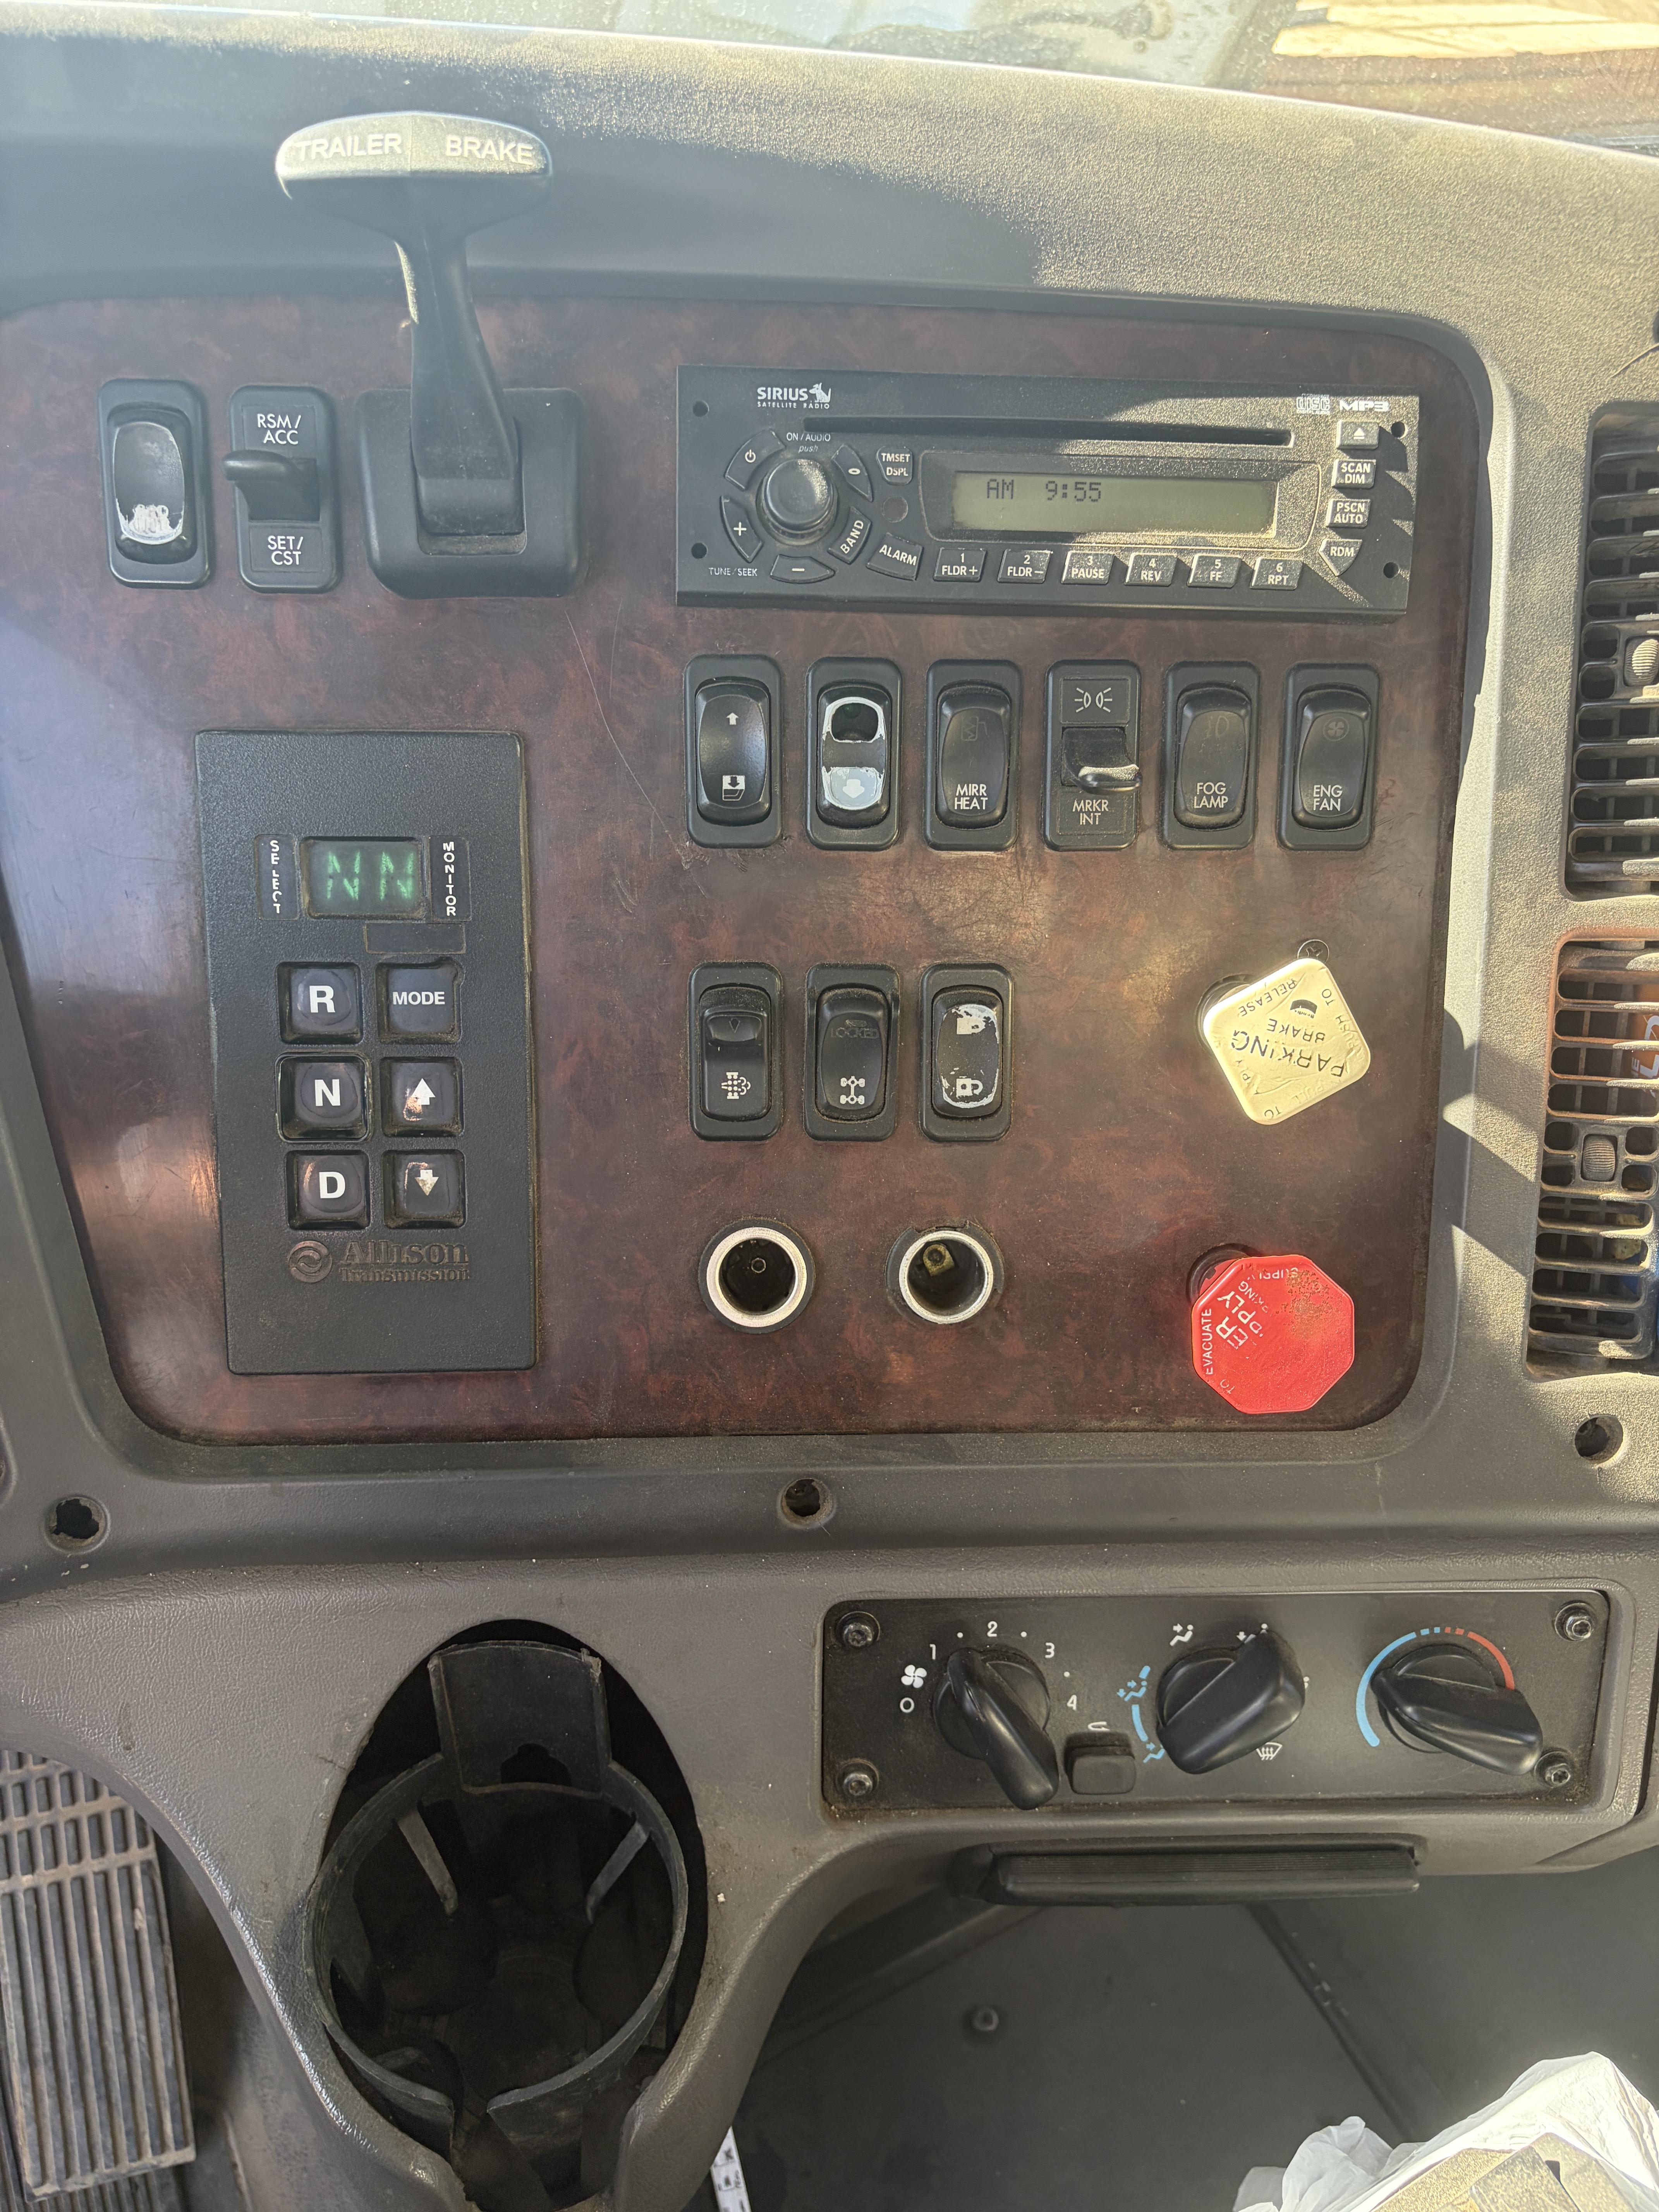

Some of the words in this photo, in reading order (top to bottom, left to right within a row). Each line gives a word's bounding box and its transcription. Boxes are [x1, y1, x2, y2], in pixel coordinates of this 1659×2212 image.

[294, 133, 402, 161] TRAILER
[446, 135, 534, 166] BRAKE
[757, 387, 808, 401] SIRIUS
[1339, 400, 1389, 412] MP3
[257, 414, 301, 428] RSM/
[263, 430, 299, 445] ACC
[881, 453, 910, 462] TMSET
[886, 467, 908, 476] DSPL
[1341, 462, 1371, 473] SCAN
[1345, 474, 1365, 484] DIM
[986, 479, 1014, 499] AM
[1046, 481, 1101, 502] 9:55
[1336, 503, 1365, 513] PSCN
[1333, 514, 1363, 524] AUTO
[268, 536, 304, 550] SET/
[840, 520, 864, 554] BAND
[271, 551, 302, 565] CST
[879, 544, 917, 566] ALARM
[960, 553, 964, 562] 1
[1330, 546, 1354, 557] RDM
[1024, 555, 1030, 564] 2
[1087, 556, 1093, 566] 3
[1149, 558, 1156, 568] 4
[1214, 559, 1221, 569] 5
[1071, 567, 1104, 579] PAUSE
[1276, 562, 1283, 572] 6
[1141, 570, 1161, 582] REV
[1210, 572, 1221, 581] FF
[1267, 575, 1289, 584] RPT
[956, 784, 987, 797] MIRR
[1197, 782, 1226, 795] FOG
[1313, 785, 1343, 798] ENG
[954, 797, 989, 811] HEAT
[1072, 799, 1109, 812] MRKR
[1194, 796, 1228, 809] LAMP
[1313, 798, 1341, 811] FAN
[1080, 812, 1101, 825] INT
[270, 840, 282, 914] SELECT
[443, 842, 456, 916] MONITOR
[309, 985, 335, 1013] R
[393, 991, 445, 1005] MODE
[1238, 979, 1298, 1017] RELEASE
[1321, 988, 1336, 1006] TO
[1267, 1018, 1326, 1044] BRAKE
[1231, 1030, 1345, 1078] PARKING
[314, 1079, 340, 1106] N
[319, 1171, 346, 1199] D
[338, 1240, 469, 1264] Allison
[339, 1267, 470, 1282] Transmission
[1201, 1308, 1214, 1375] EVACUATE
[1220, 1379, 1236, 1394] TO
[987, 1621, 998, 1637] 2
[929, 1644, 936, 1660] 1
[1045, 1642, 1055, 1658] 3
[1067, 1695, 1077, 1711] 4
